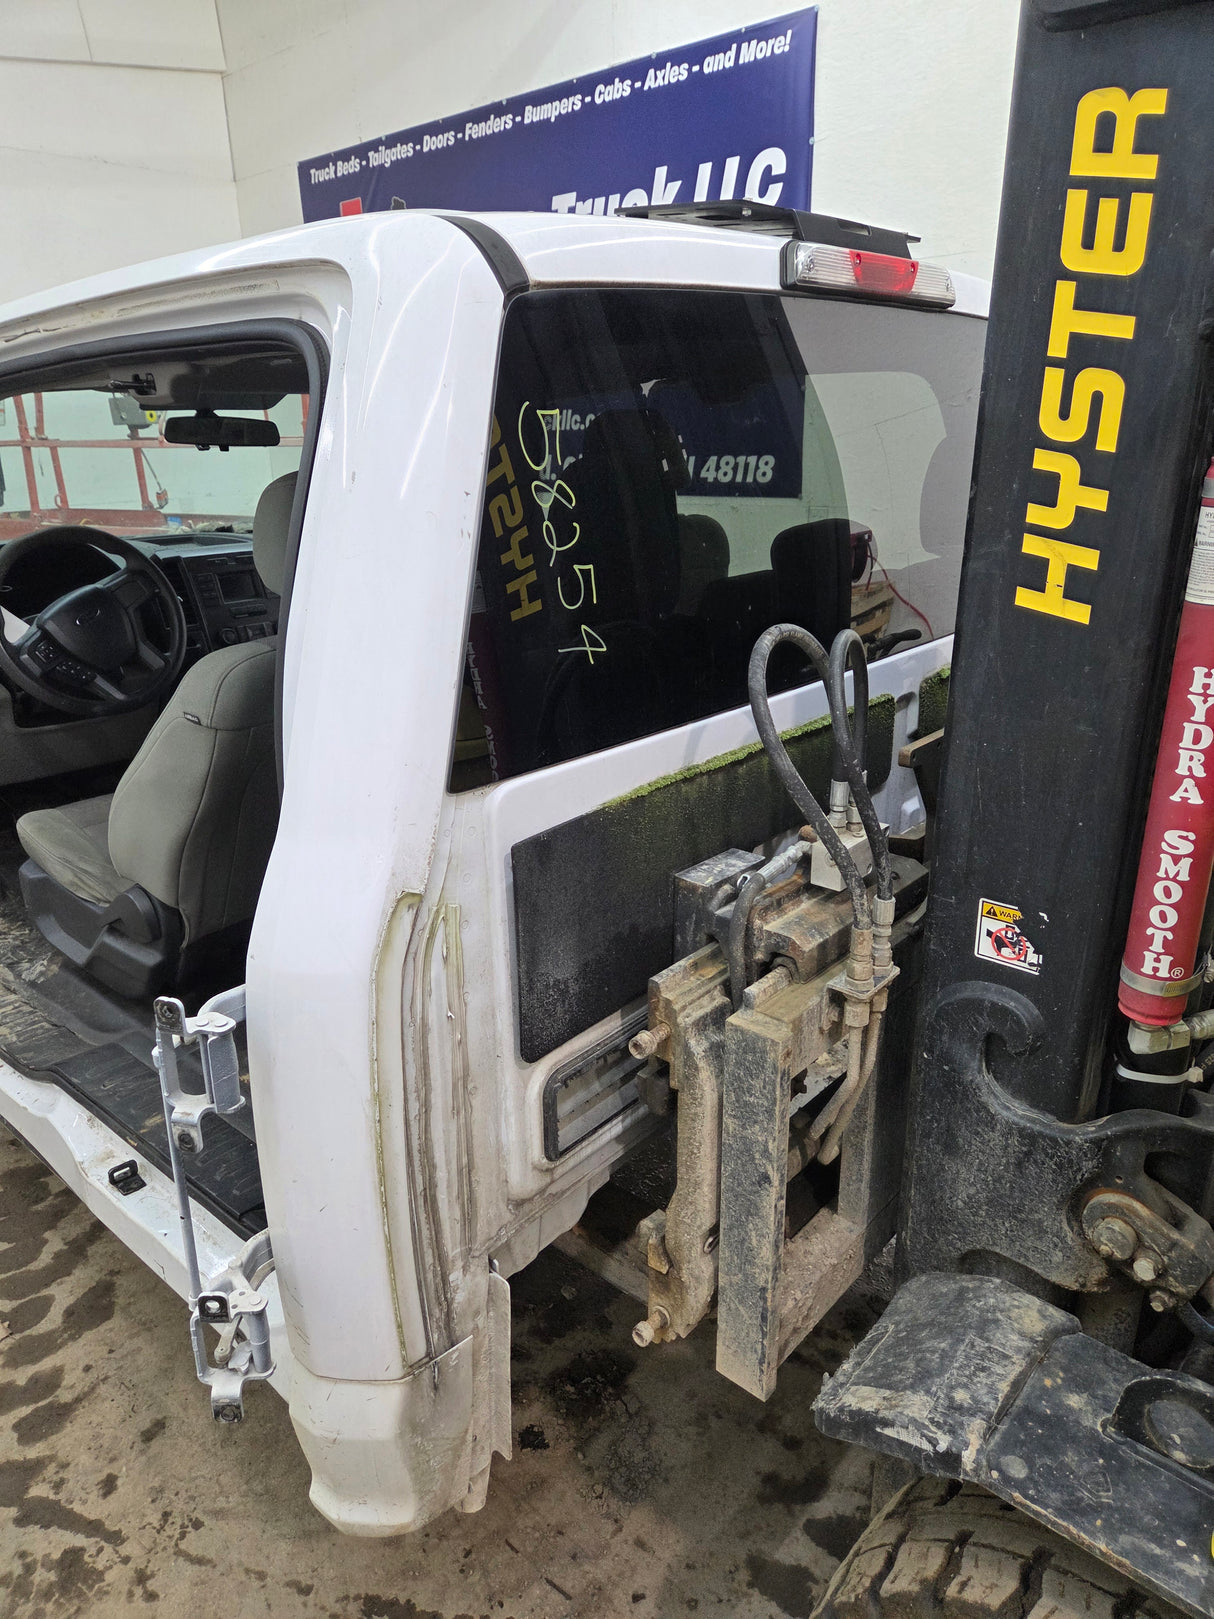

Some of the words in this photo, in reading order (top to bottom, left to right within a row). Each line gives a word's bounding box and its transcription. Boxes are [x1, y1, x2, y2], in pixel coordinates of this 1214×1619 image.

[309, 162, 336, 185] Truck
[336, 155, 361, 177] Beds
[367, 142, 414, 168] Tailgates
[422, 130, 455, 153] Doors
[464, 114, 514, 142] Fenders
[523, 93, 583, 124] Bumpers
[594, 77, 632, 105] Cabs
[643, 61, 689, 91] Axles
[702, 43, 738, 75] and
[738, 28, 793, 65] More!
[1014, 86, 1169, 626] HYSTER
[700, 454, 776, 484] 48118
[1169, 666, 1214, 805] HYDRA
[999, 909, 1024, 921] WAR
